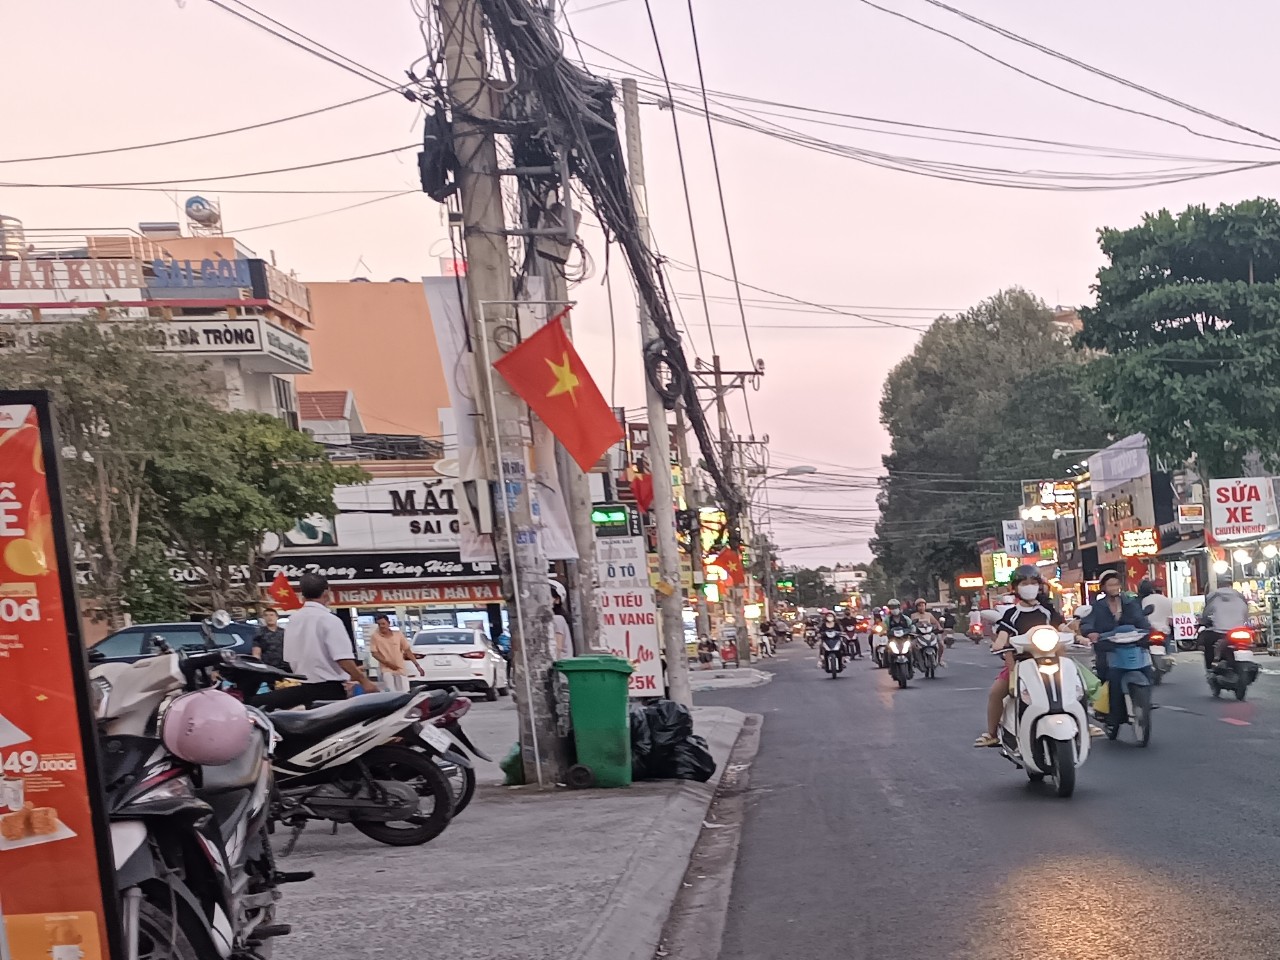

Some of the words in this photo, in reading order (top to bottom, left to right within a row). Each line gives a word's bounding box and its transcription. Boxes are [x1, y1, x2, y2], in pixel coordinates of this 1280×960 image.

[203, 324, 255, 345] TRÒNG
[1216, 480, 1261, 504] SỬA
[1225, 506, 1254, 524] XE
[613, 590, 643, 607] TIẾU
[619, 612, 655, 626] VANG
